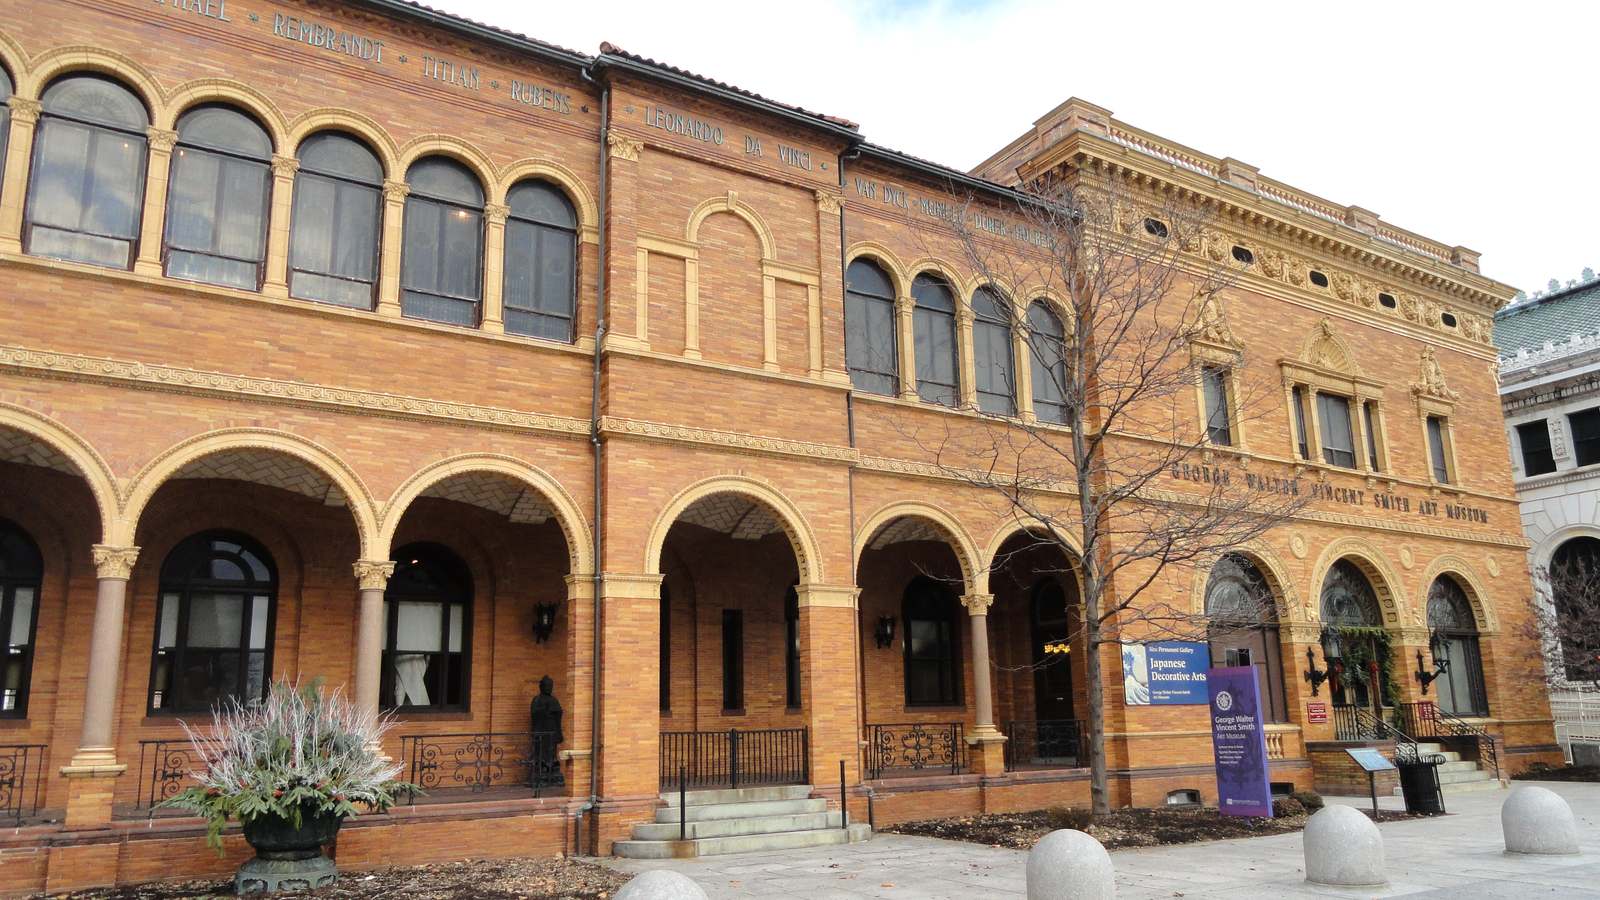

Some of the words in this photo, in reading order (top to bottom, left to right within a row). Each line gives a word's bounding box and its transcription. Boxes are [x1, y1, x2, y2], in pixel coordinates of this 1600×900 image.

[273, 10, 384, 63] REMBRANDT
[423, 53, 480, 90] TITIAN
[511, 79, 571, 114] RUBENS
[644, 105, 724, 145] LEONARDO
[744, 135, 763, 157] DA
[778, 143, 813, 171] VINCI
[855, 176, 877, 200] VAN
[882, 185, 909, 209] DYCK
[1171, 463, 1230, 485] GEORGE
[1246, 473, 1299, 496] WALTER
[1311, 483, 1364, 505] VINCENT
[1375, 493, 1410, 513] SMITH
[1418, 500, 1439, 517] ART
[1446, 503, 1489, 523] MUSEUM
[1150, 658, 1186, 671] Japanese
[1151, 671, 1190, 681] Decorative
[1191, 671, 1207, 681] Arts
[1215, 716, 1235, 724] George
[1235, 715, 1255, 723] Walter
[1237, 723, 1256, 731] Smith
